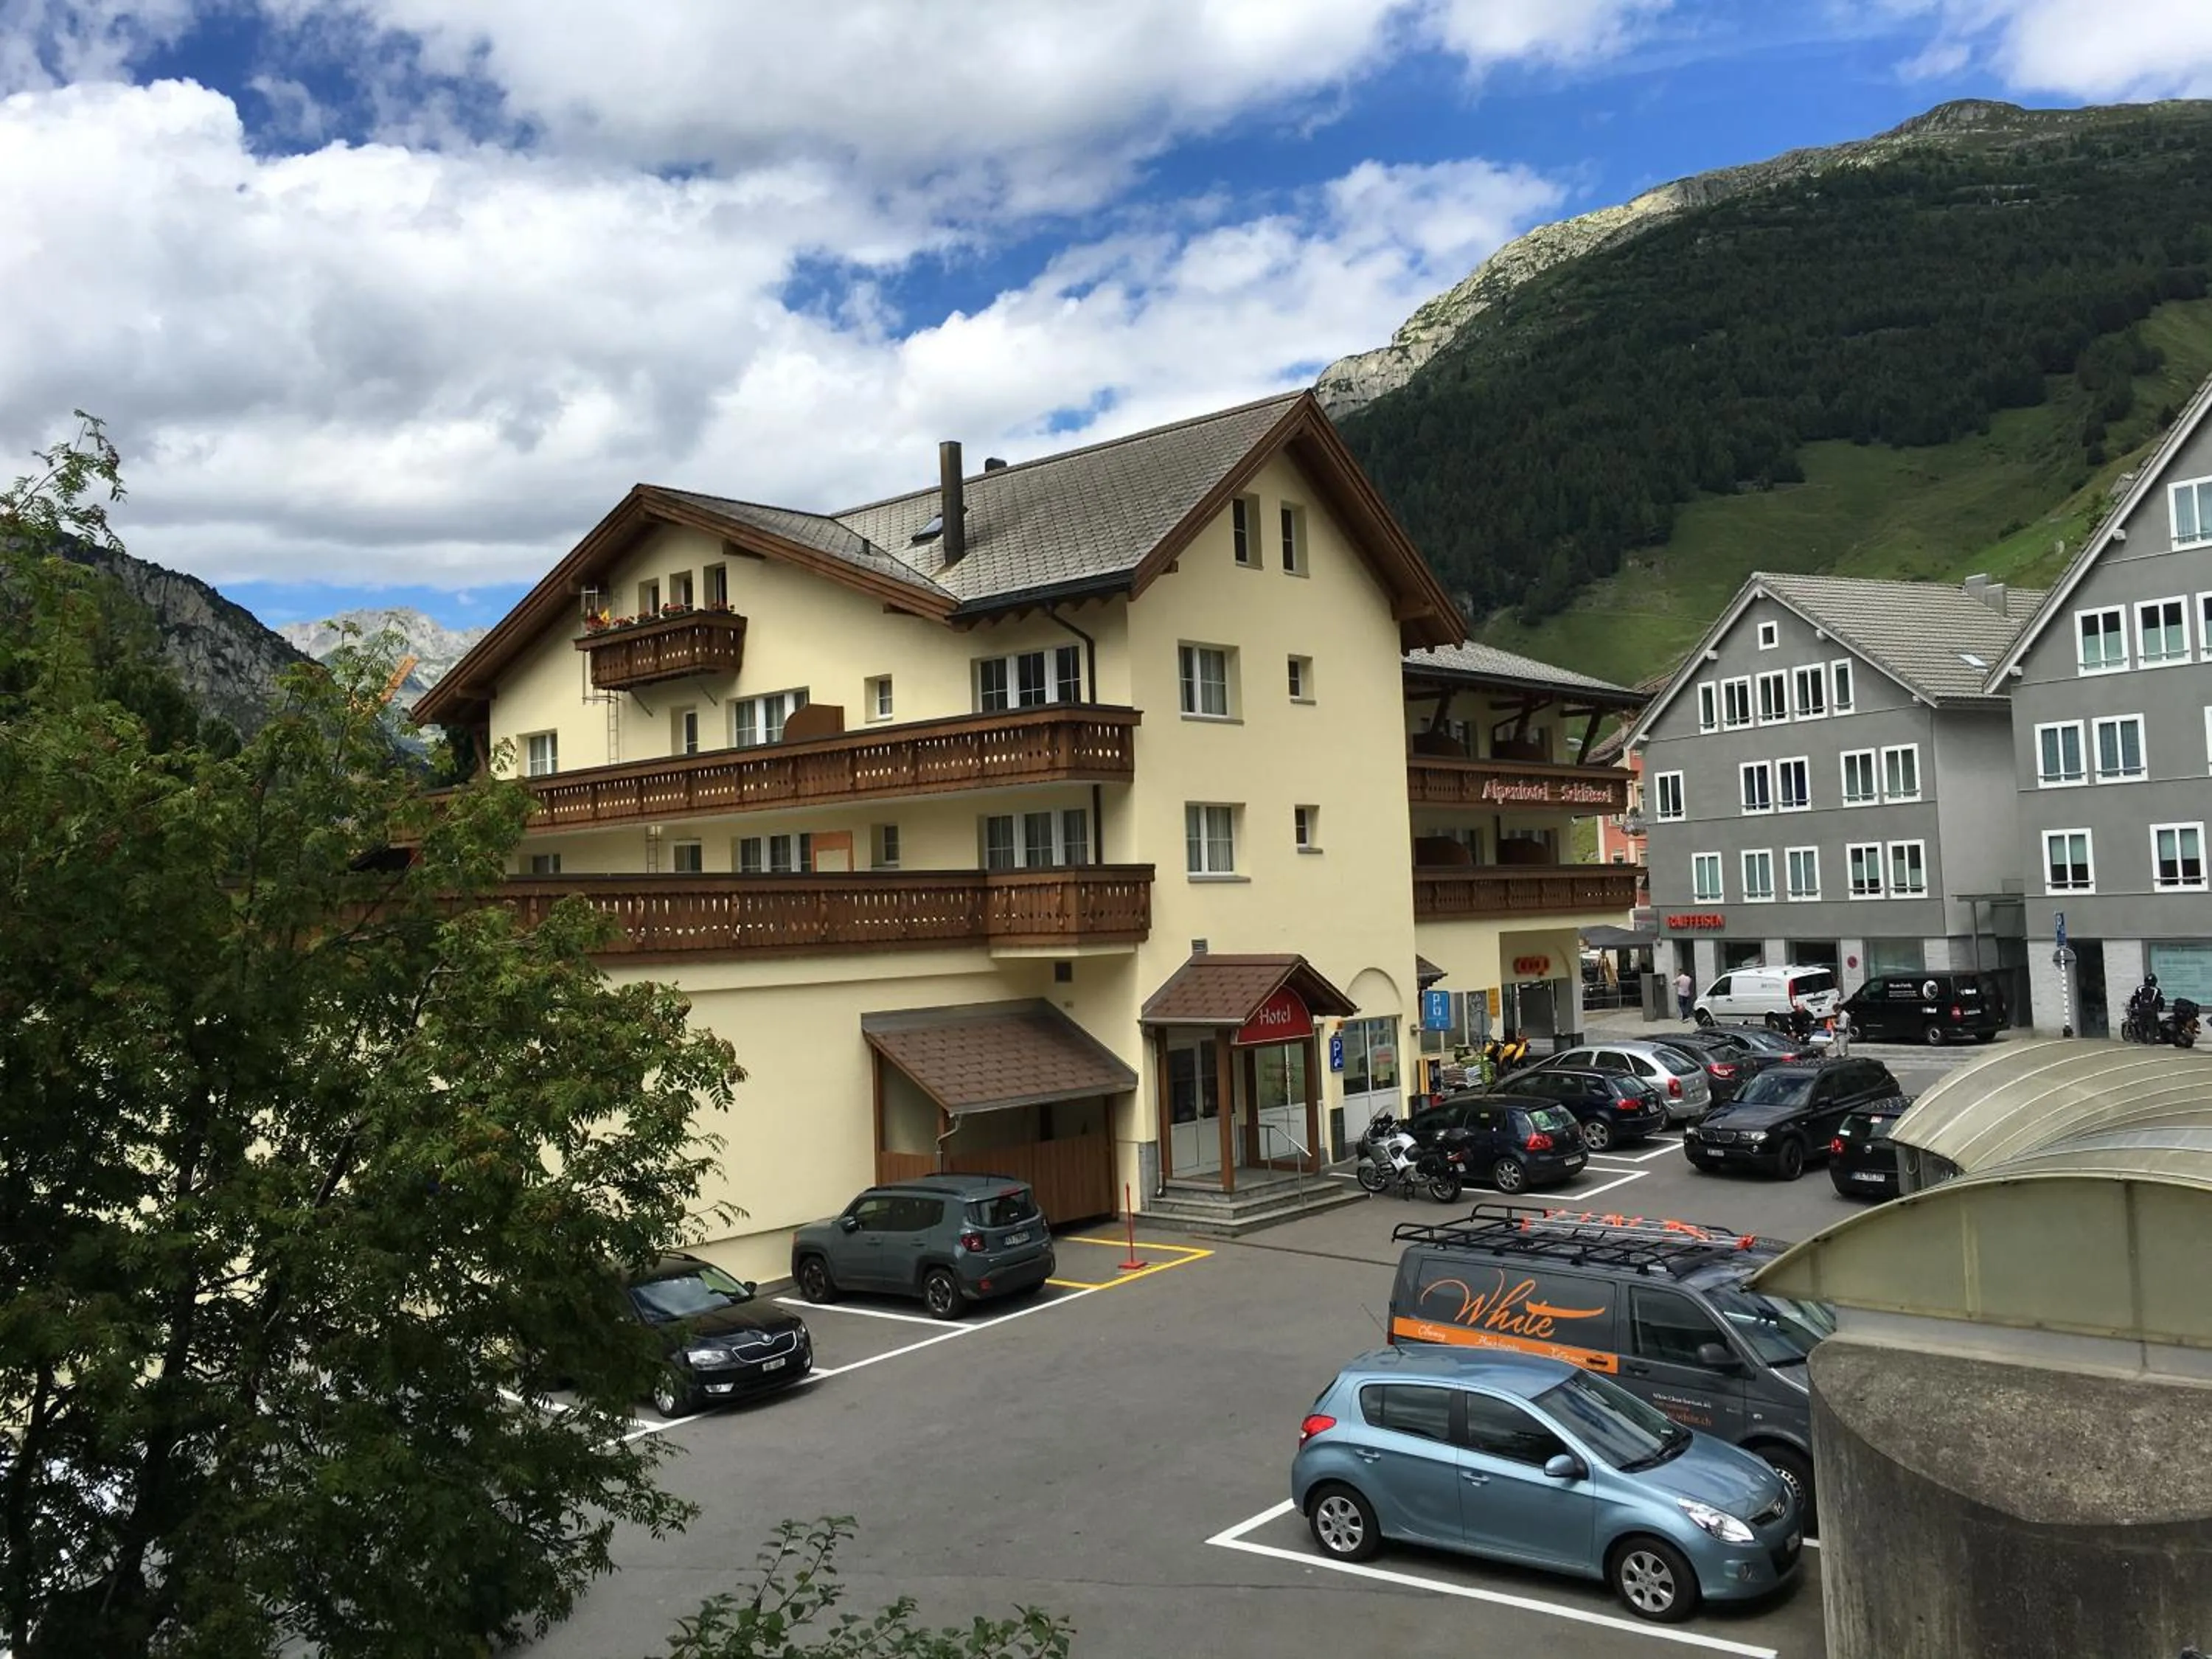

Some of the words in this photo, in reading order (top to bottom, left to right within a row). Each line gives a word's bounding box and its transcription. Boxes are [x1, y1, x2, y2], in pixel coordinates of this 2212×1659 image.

[1259, 1004, 1291, 1026] Hotel
[1332, 1040, 1341, 1057] P
[1420, 1266, 1606, 1338] White
